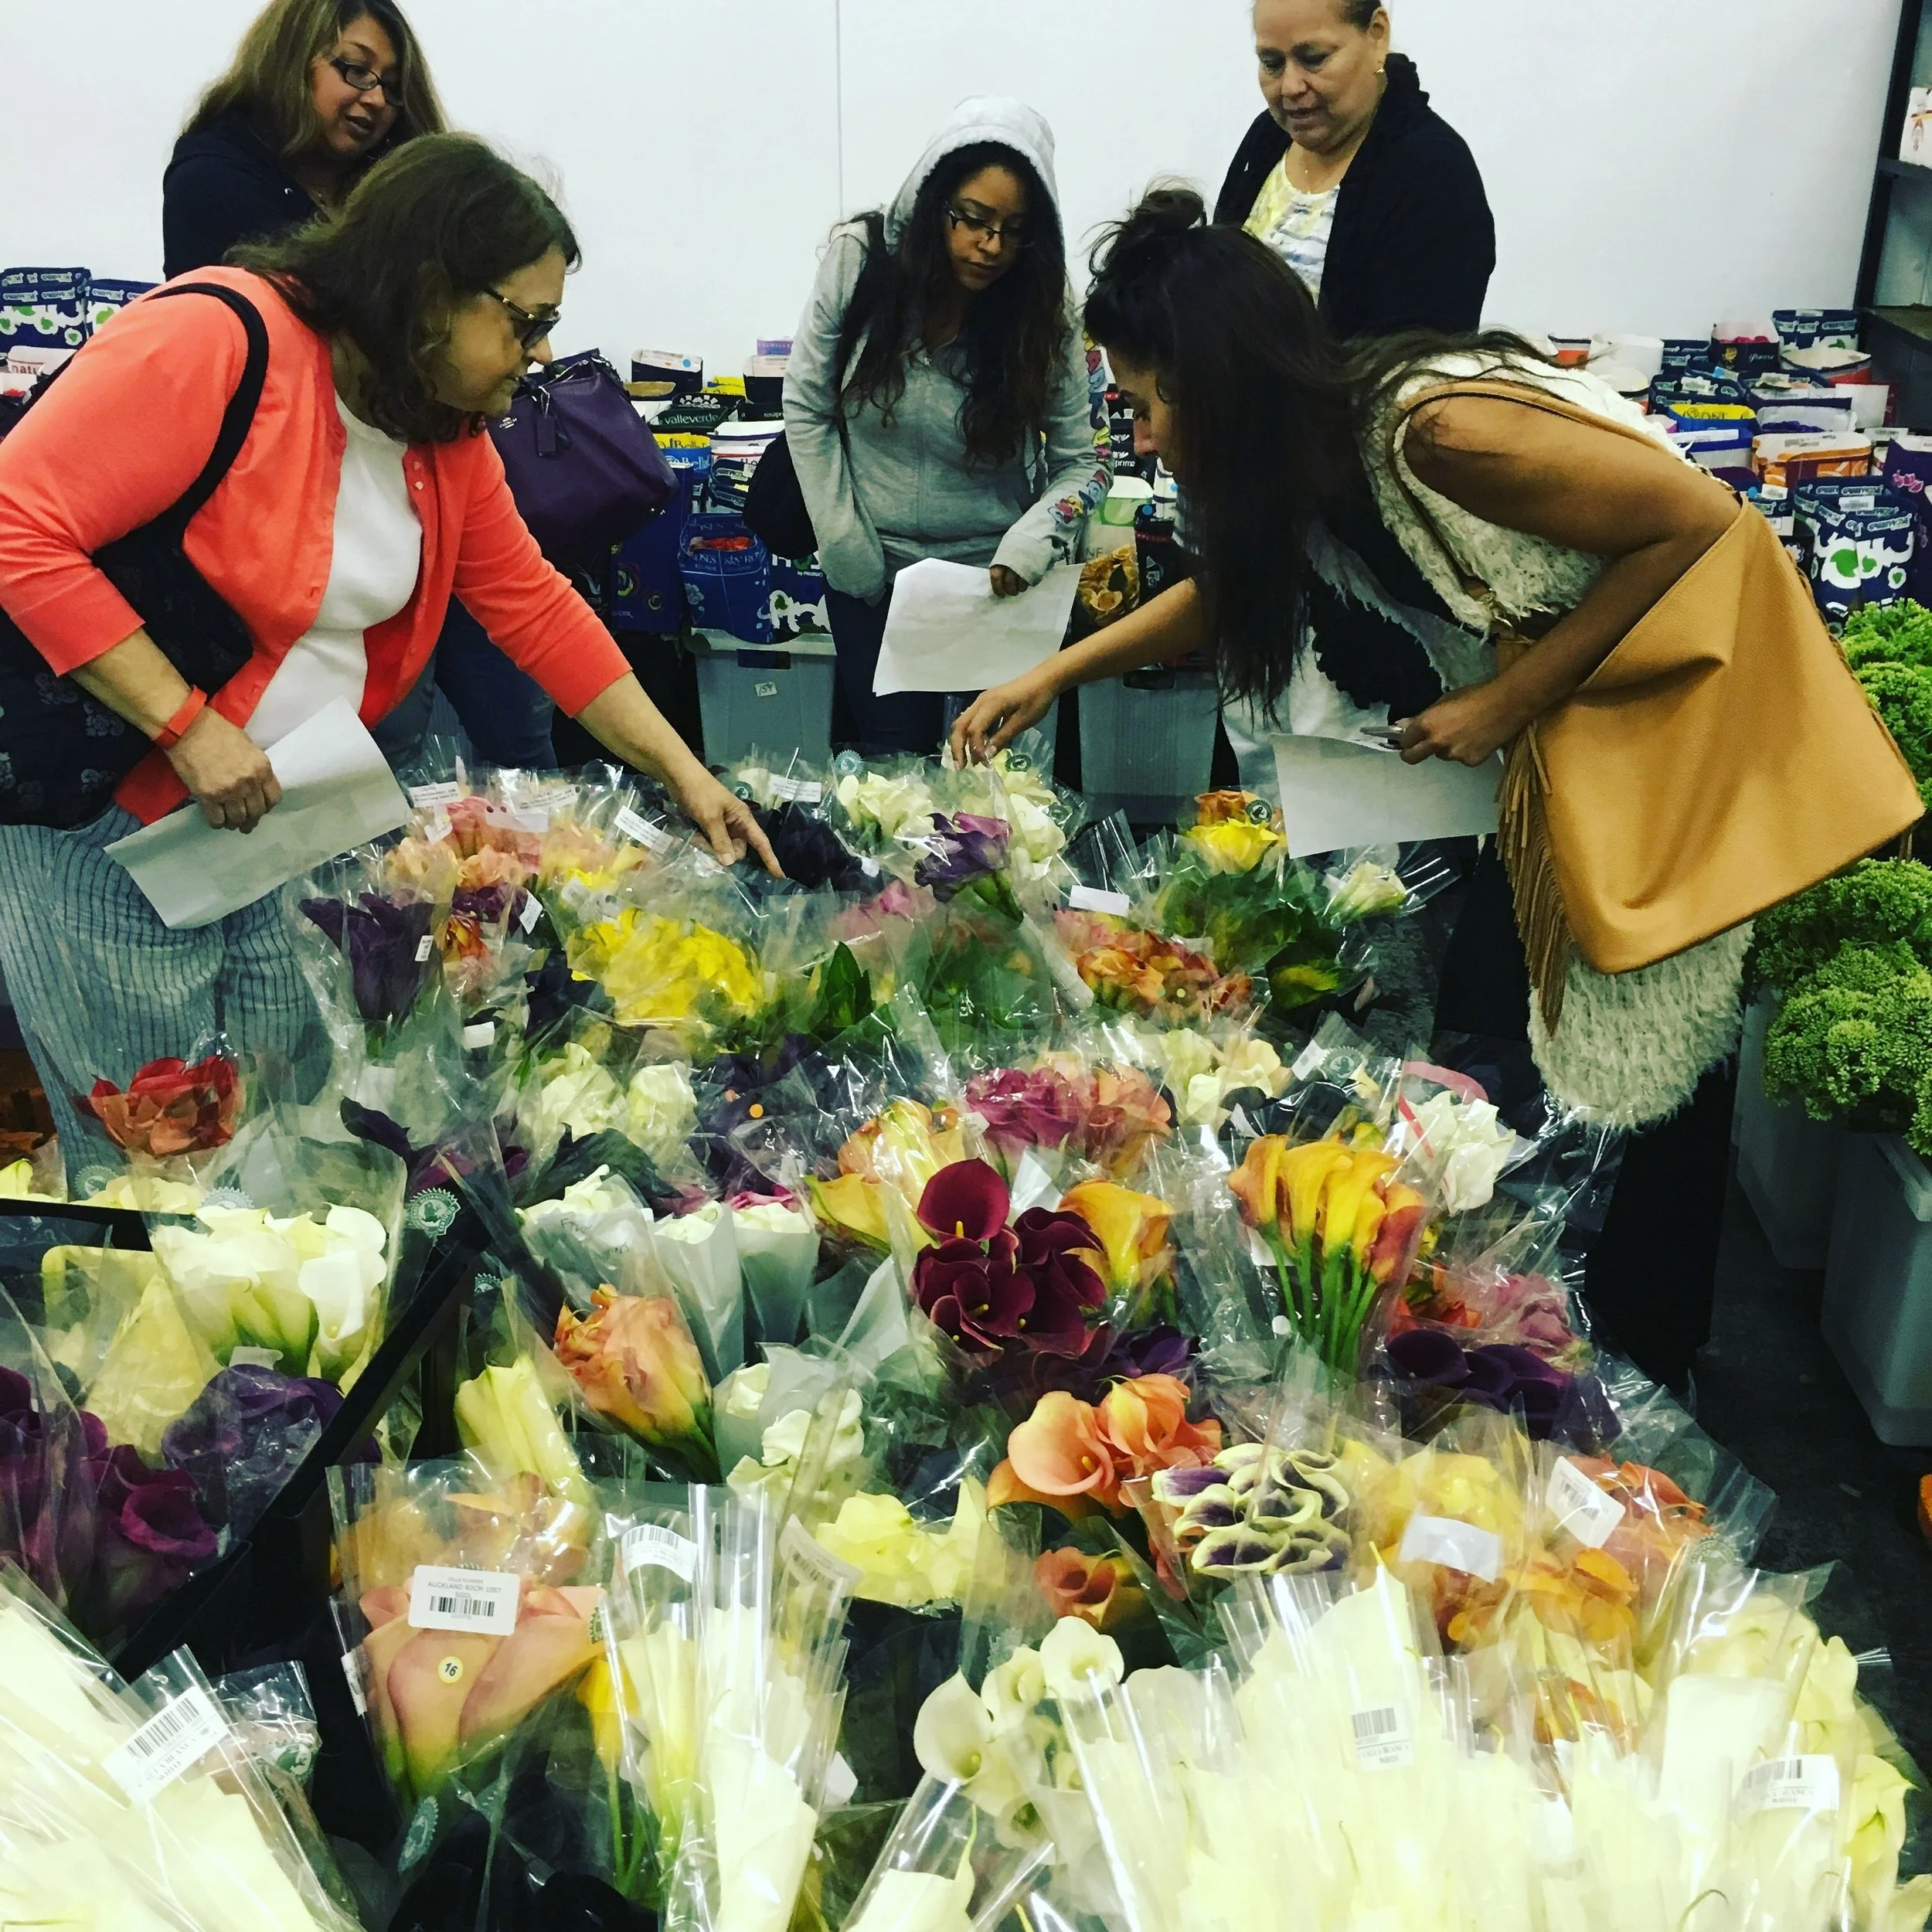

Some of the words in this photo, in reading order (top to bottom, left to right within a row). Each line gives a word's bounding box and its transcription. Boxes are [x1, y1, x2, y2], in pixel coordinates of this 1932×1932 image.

[665, 413, 720, 424] valleverde
[427, 1581, 463, 1590] AUCKLAND
[444, 1662, 458, 1676] 16
